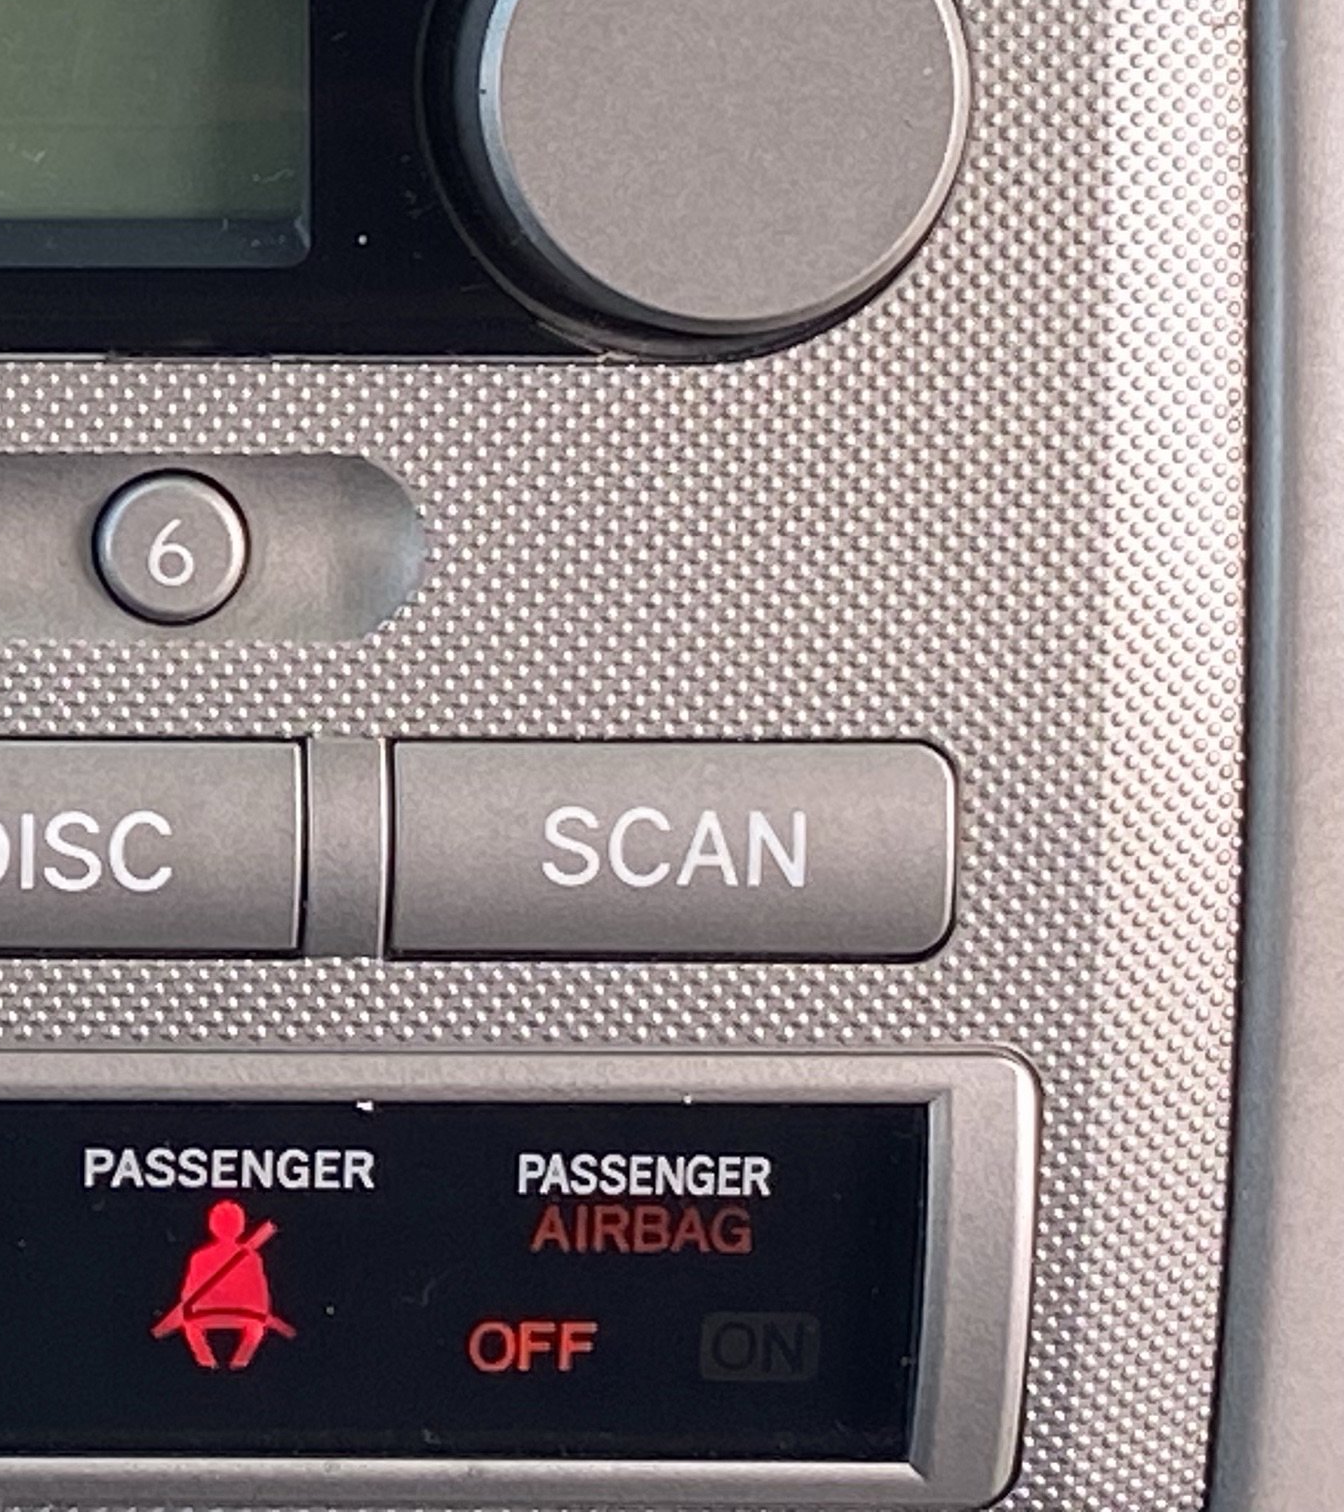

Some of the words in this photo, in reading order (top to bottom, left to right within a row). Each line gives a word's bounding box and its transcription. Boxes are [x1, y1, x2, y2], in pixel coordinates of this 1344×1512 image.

[147, 518, 195, 587] 6
[541, 805, 807, 888] SCAN
[82, 1148, 376, 1190] PASSENGER
[518, 1153, 772, 1197] PASSENGER
[530, 1205, 753, 1255] AIRBAG
[466, 1320, 599, 1373] OFF
[714, 1320, 805, 1373] ON
